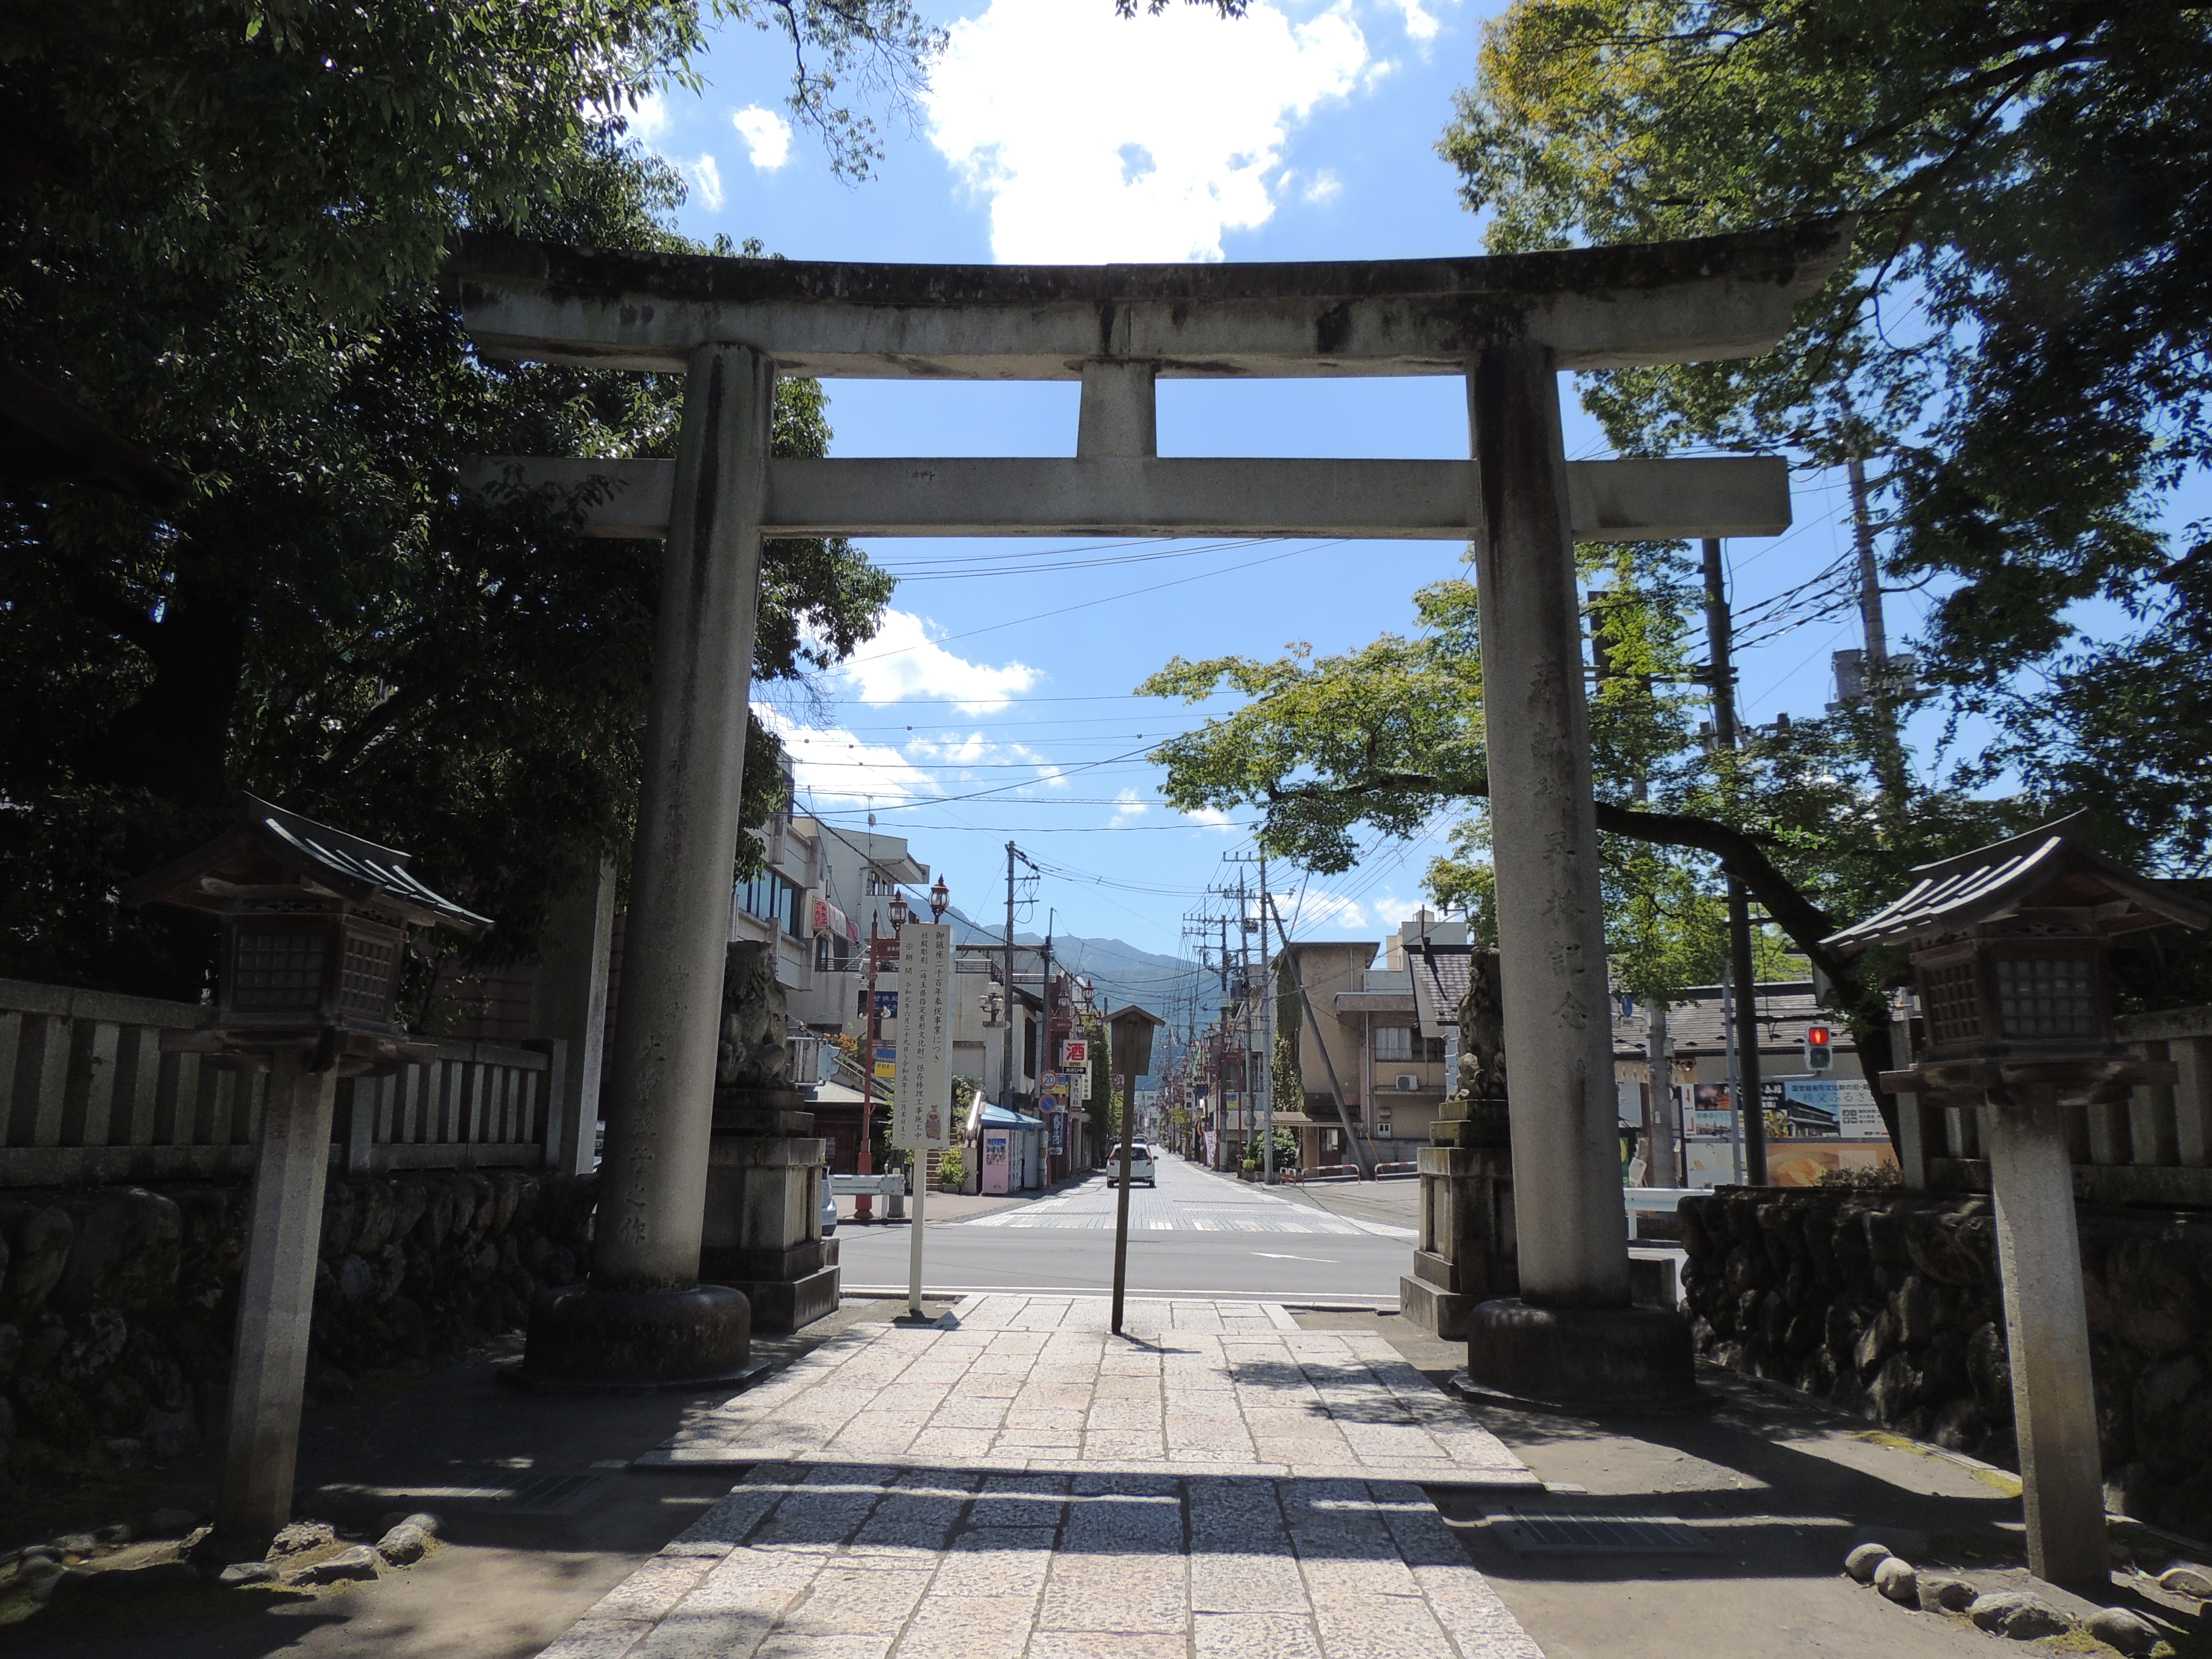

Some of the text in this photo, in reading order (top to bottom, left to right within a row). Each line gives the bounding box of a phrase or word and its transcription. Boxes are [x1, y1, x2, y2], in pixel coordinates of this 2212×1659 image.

[933, 932, 945, 1063] 御鎮座二千百年奉祝事業につき
[1066, 1043, 1085, 1061] 酒
[1044, 1076, 1054, 1084] 20
